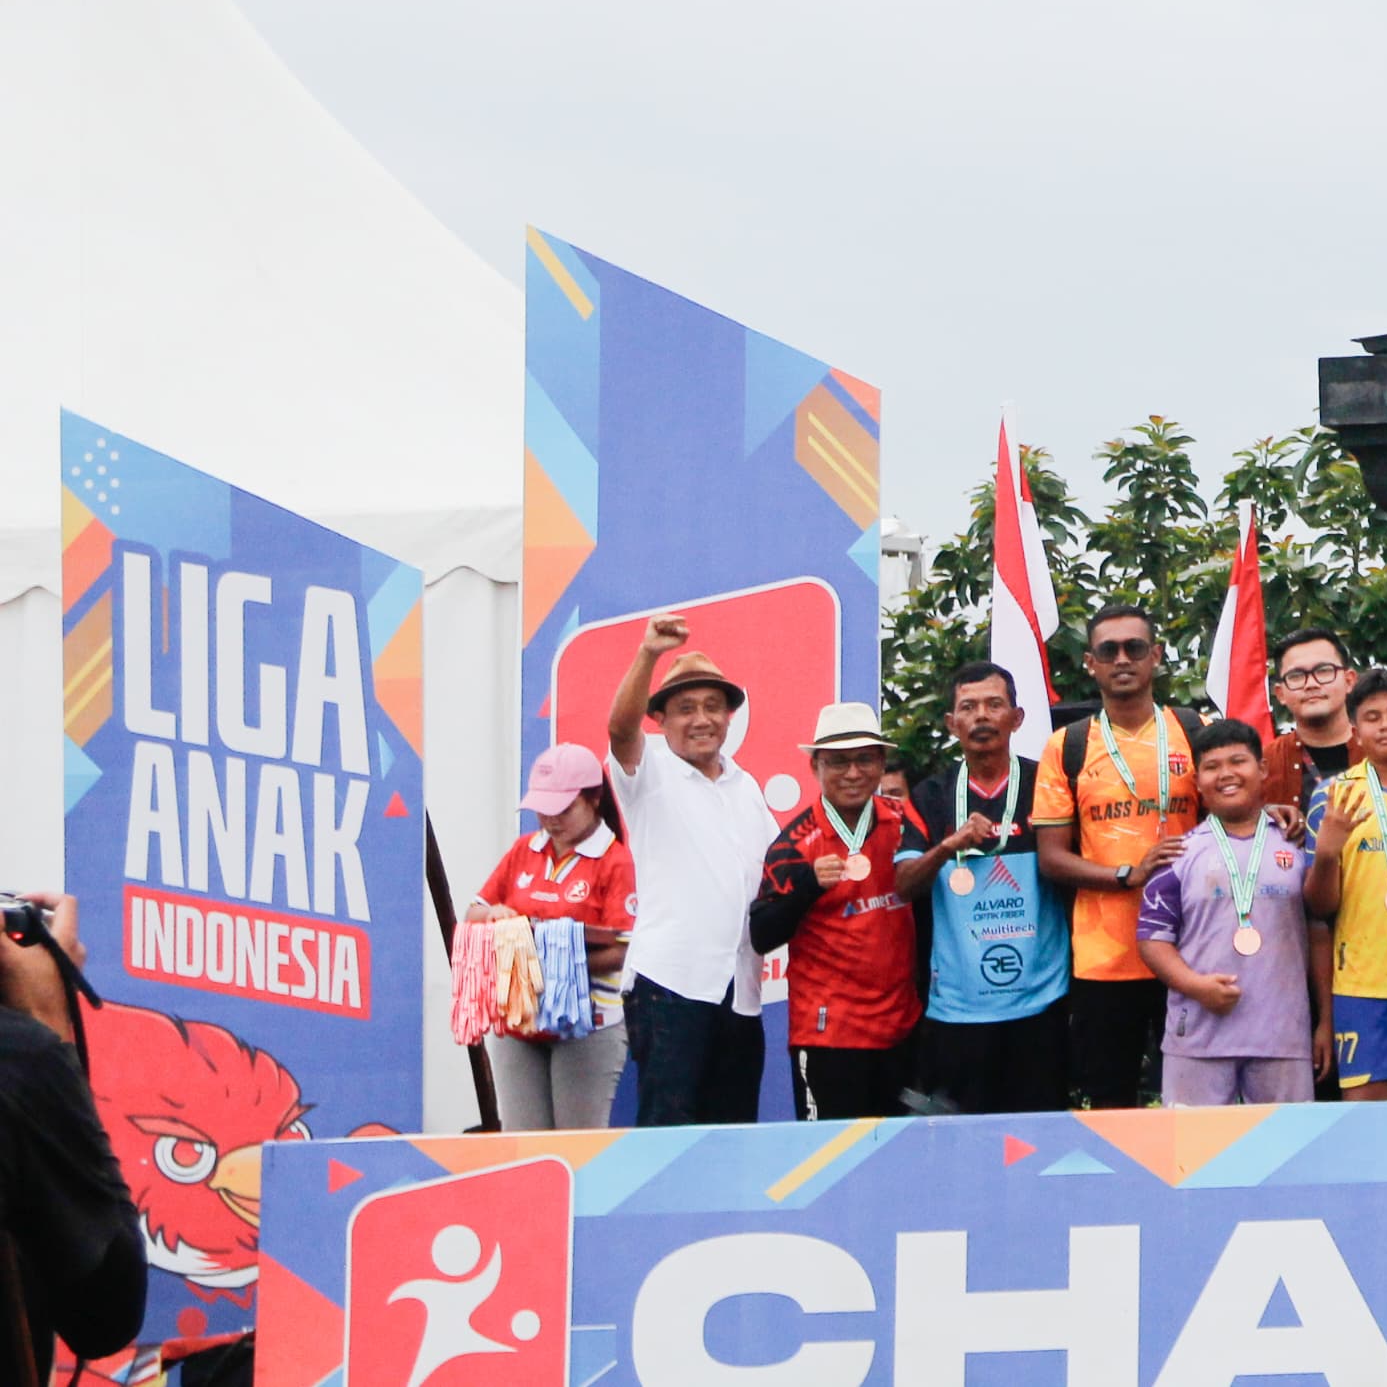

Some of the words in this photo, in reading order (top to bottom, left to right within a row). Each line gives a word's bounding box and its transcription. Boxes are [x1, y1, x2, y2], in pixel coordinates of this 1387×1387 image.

[123, 551, 370, 776] LIGA
[124, 740, 370, 923] ANAK
[131, 896, 361, 1009] INDONESIA
[973, 897, 1024, 911] ALVARO
[981, 923, 1036, 936] Multitech
